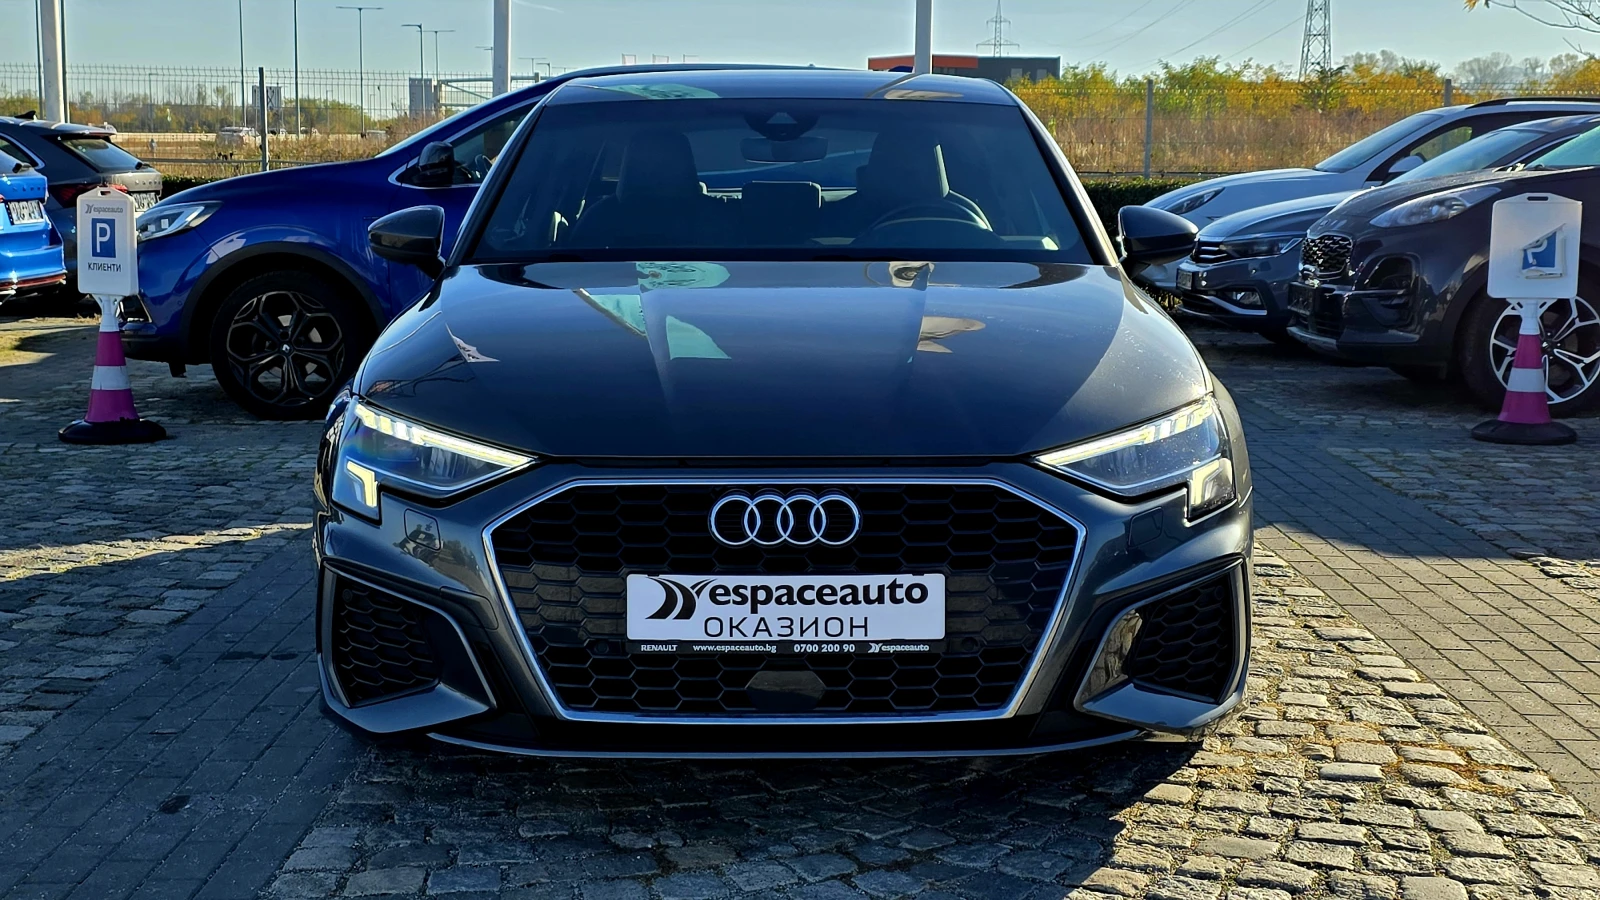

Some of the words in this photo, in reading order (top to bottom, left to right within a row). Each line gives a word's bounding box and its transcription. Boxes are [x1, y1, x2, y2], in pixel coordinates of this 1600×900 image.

[93, 206, 123, 214] espaceauto
[96, 222, 111, 253] P
[87, 262, 121, 273] КЛИЕНТИ
[708, 578, 928, 614] espaceauto
[704, 616, 868, 638] ОКАЗИОН
[641, 644, 678, 652] RENAULT
[693, 643, 776, 653] www.espaceauto.bg
[793, 643, 819, 653] 0700
[821, 643, 840, 653] 200
[843, 643, 856, 653] 90
[881, 643, 930, 653] espaceauto
